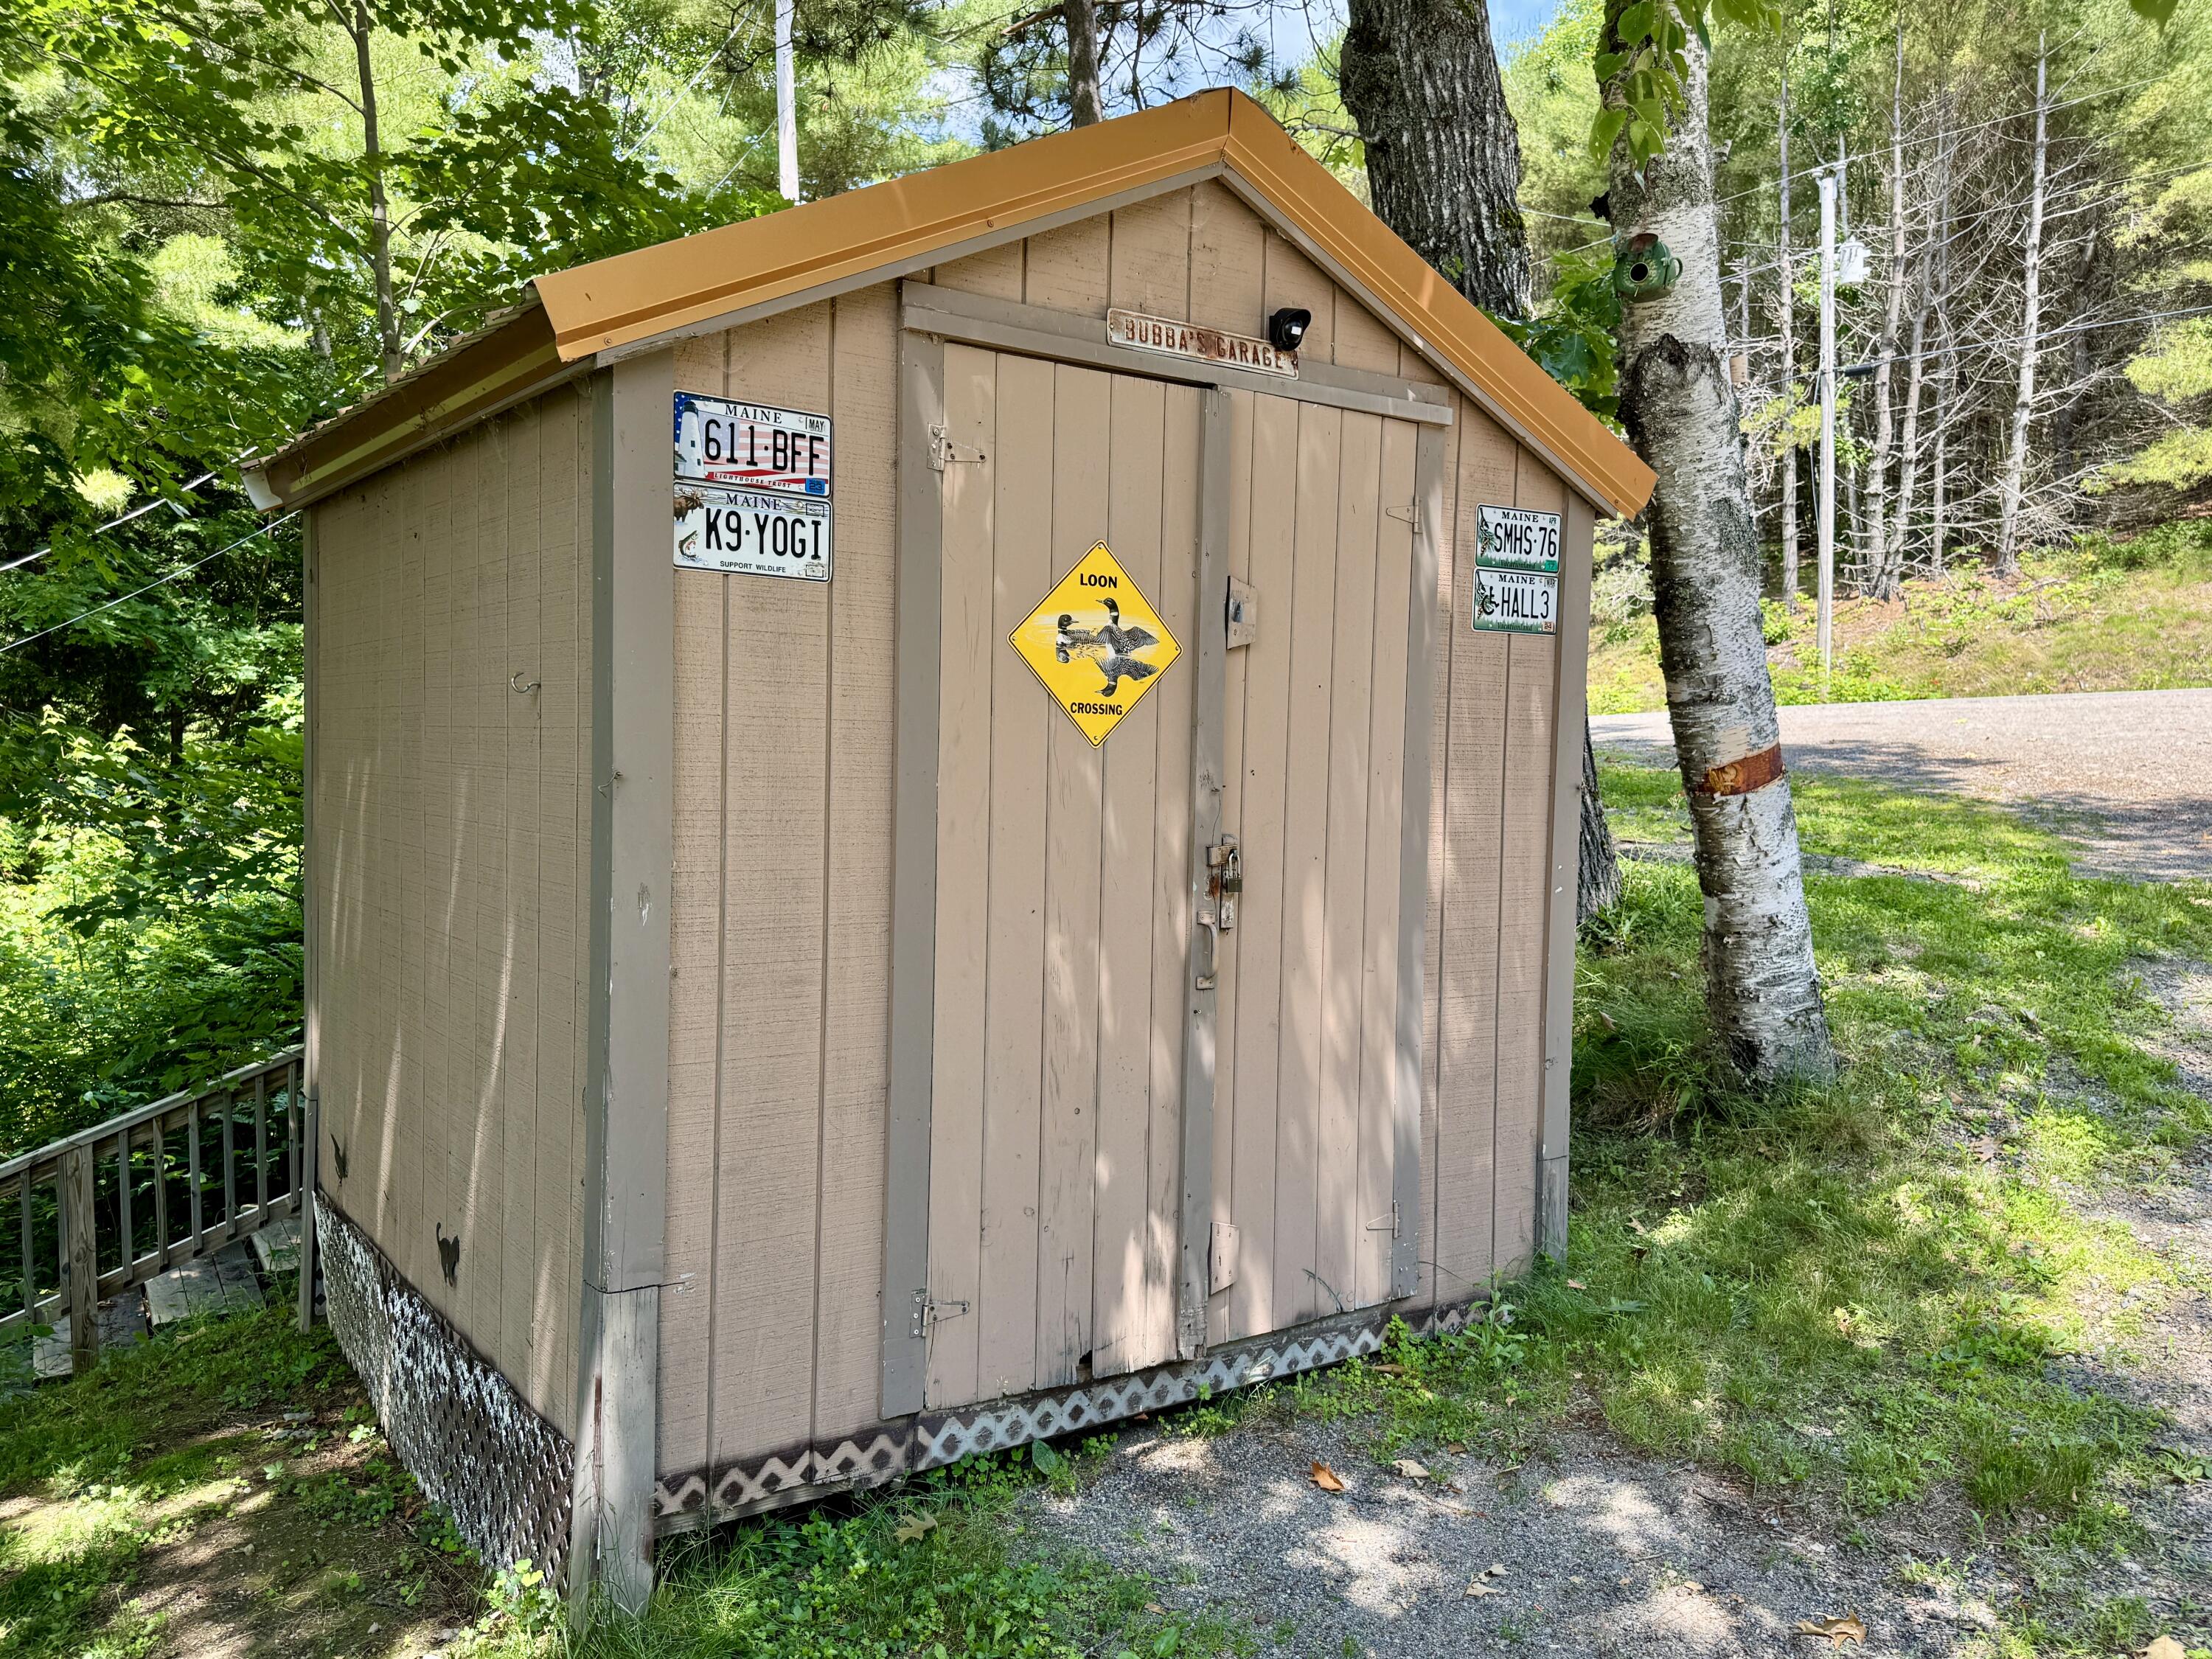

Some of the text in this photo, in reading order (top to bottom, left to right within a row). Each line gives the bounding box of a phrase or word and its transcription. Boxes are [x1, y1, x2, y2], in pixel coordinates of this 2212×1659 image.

[1125, 319, 1283, 369] BUBBA'S GARAGE
[725, 404, 782, 424] MAINE
[809, 418, 824, 432] MAY
[714, 473, 791, 488] LIGHTHOUSE TRUST
[809, 482, 823, 491] 23
[726, 493, 782, 511] MAINE
[1501, 511, 1539, 523] MAINE
[720, 560, 787, 573] SUPPORT WILDLIFE
[1500, 559, 1537, 569] Vacationland
[1079, 573, 1118, 588] LOON
[1498, 574, 1536, 585] MAINE
[1497, 622, 1533, 632] Vacationland
[1070, 702, 1123, 715] CROSSING
